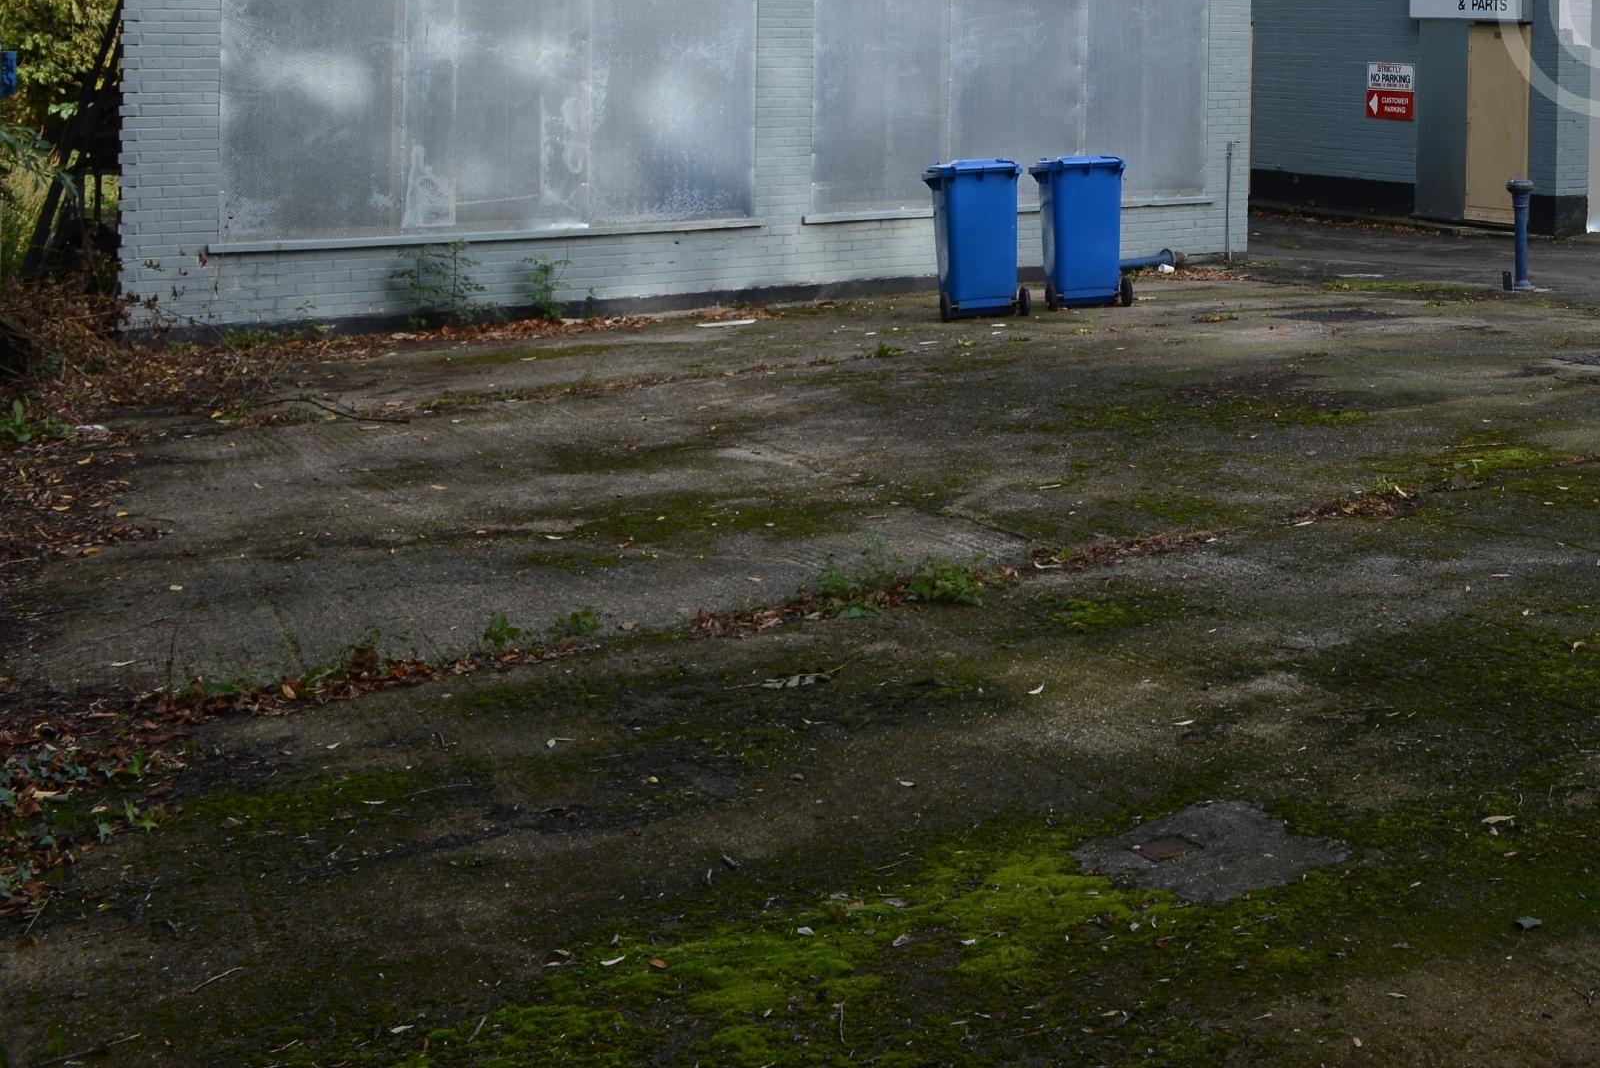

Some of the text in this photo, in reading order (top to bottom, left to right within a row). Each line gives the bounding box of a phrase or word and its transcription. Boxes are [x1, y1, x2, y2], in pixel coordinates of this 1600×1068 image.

[1377, 65, 1401, 73] STRICTLY
[1371, 74, 1410, 83] NO PARKING
